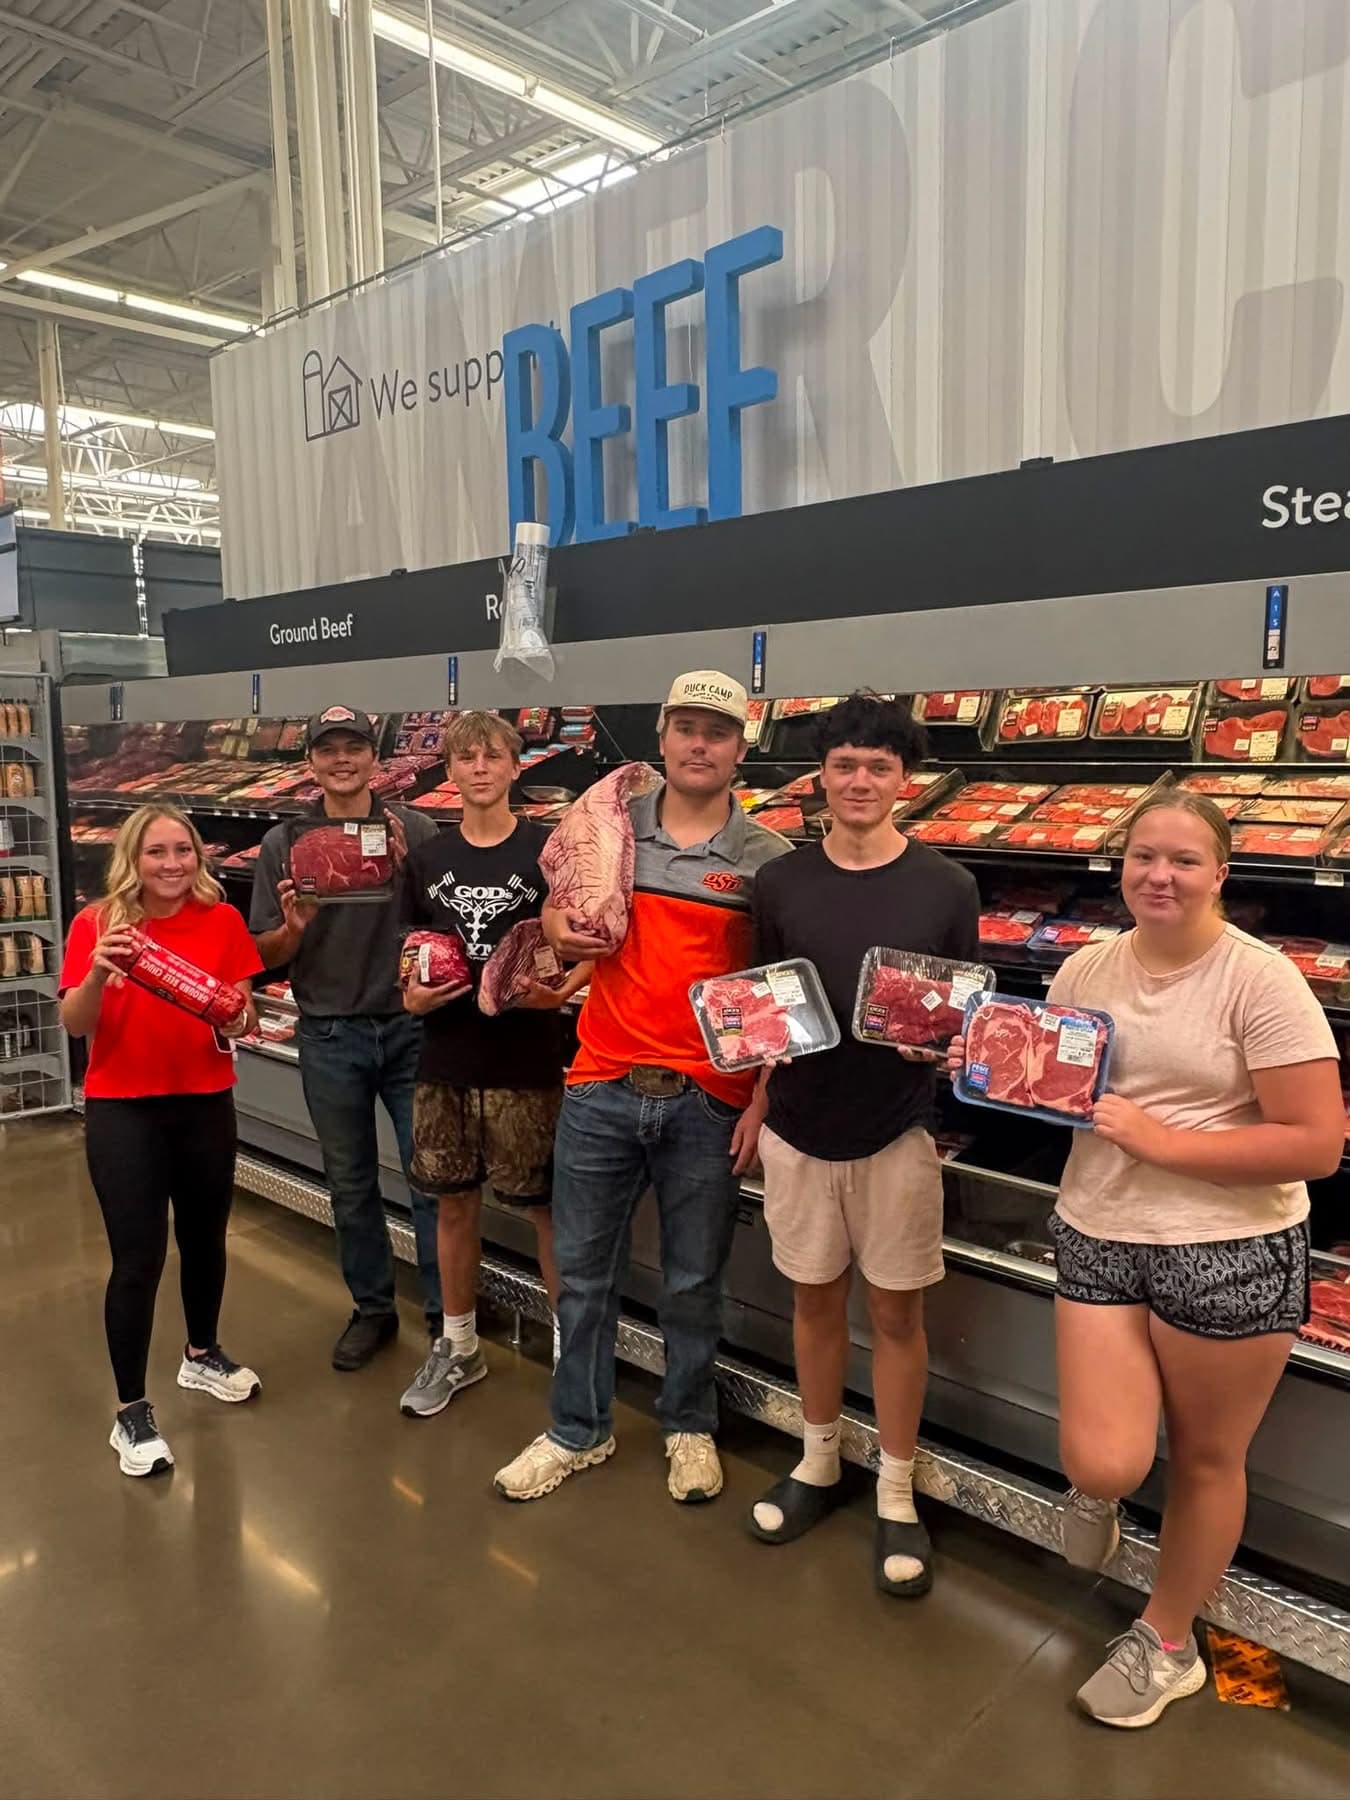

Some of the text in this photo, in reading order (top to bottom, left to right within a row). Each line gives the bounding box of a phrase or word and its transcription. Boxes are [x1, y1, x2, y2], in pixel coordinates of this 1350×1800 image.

[370, 349, 505, 420] We supp
[503, 225, 783, 554] BEEF
[485, 594, 503, 620] R
[269, 613, 353, 645] Ground Beef
[684, 682, 707, 695] DUCK
[708, 684, 733, 700] CAMP
